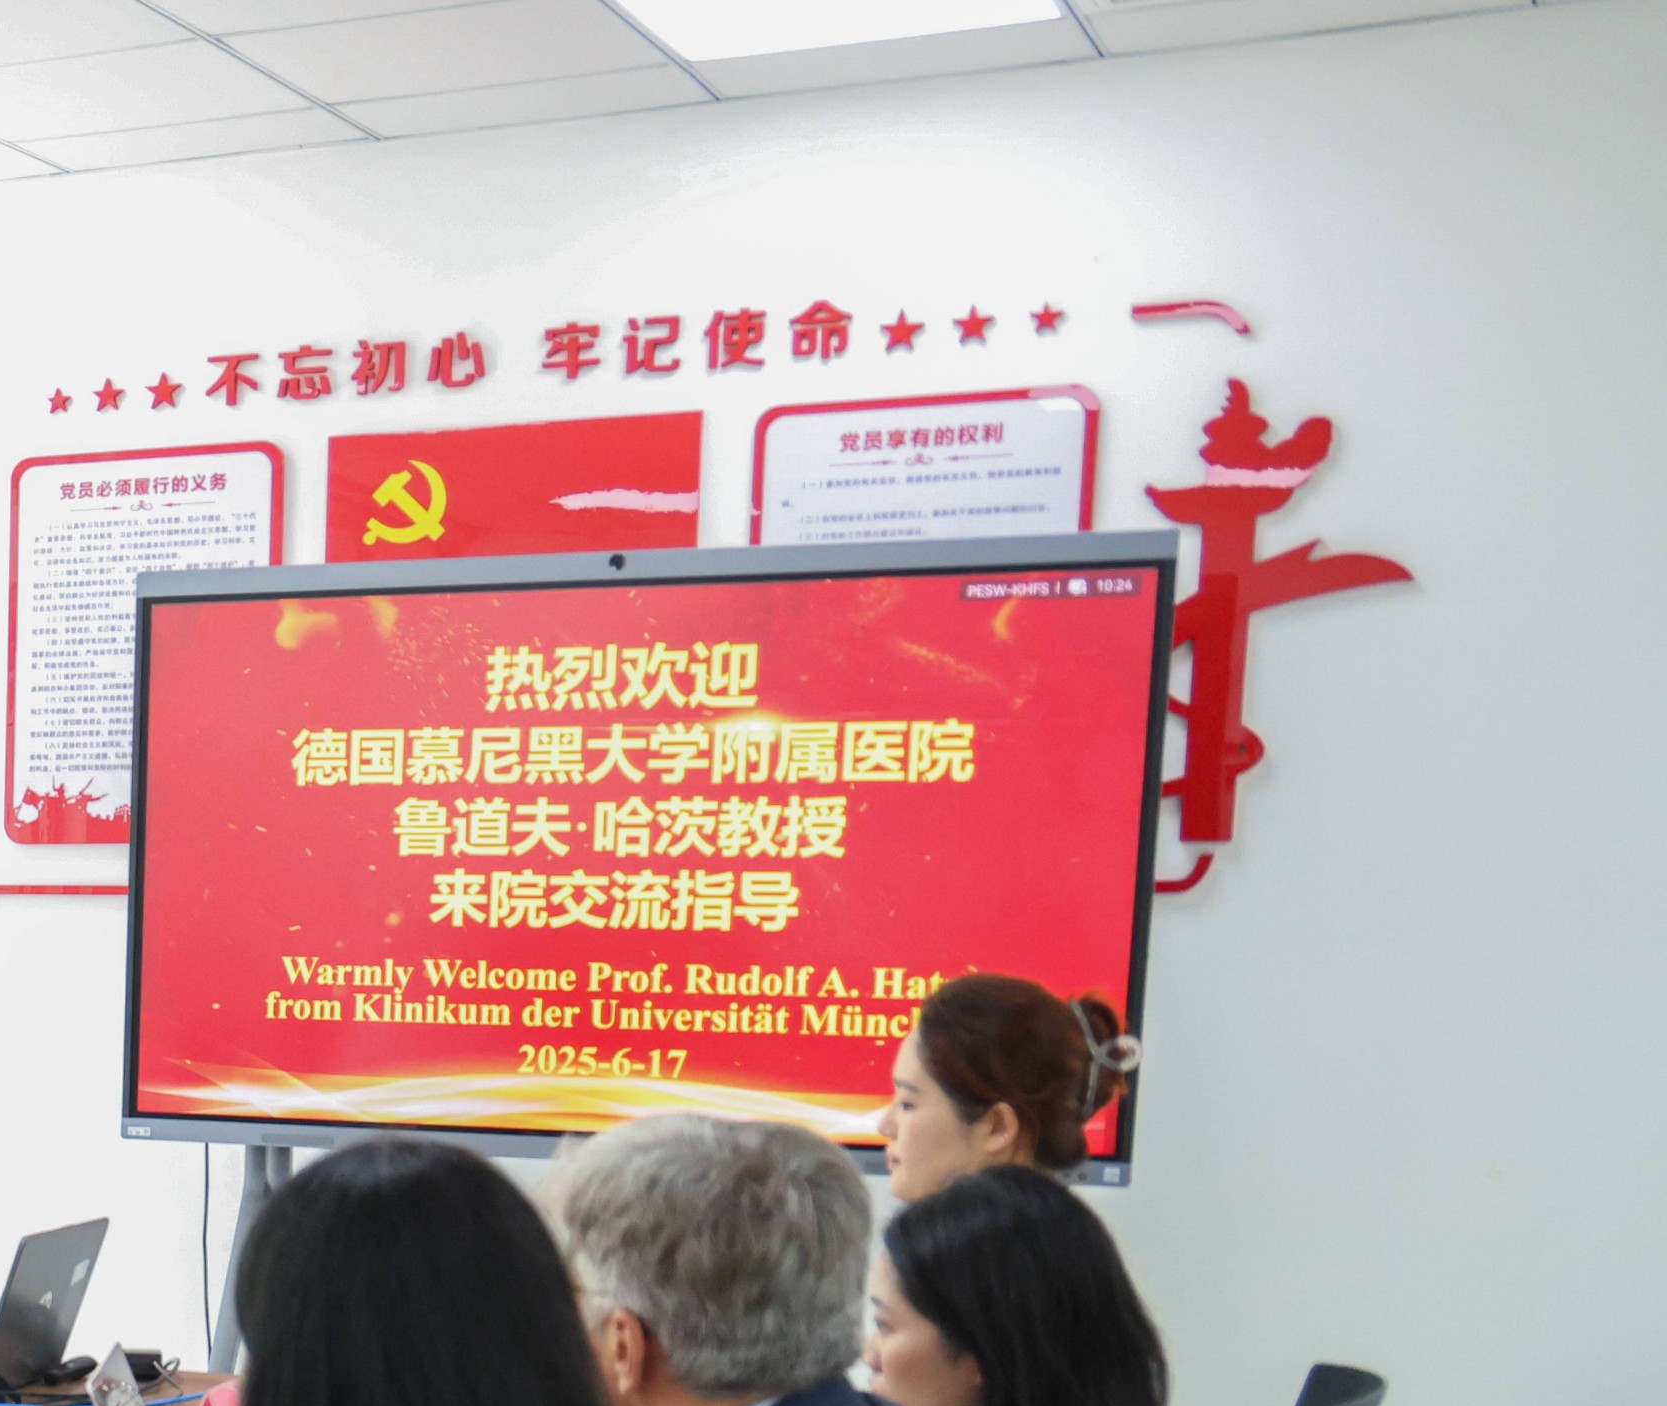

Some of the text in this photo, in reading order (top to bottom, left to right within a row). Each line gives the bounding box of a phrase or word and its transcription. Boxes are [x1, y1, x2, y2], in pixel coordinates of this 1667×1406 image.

[205, 299, 854, 407] 不忘初心 牢记使命
[839, 421, 1005, 453] 党员享有的权利
[59, 472, 228, 501] 党员必须履行的义务
[485, 641, 759, 712] 热烈欢迎
[291, 717, 976, 787] 德国慕尼黑大学附属医院
[430, 868, 799, 933] 来院交流指导
[281, 955, 944, 1002] Warmly Welcome Prof. Rudolf A. Hat
[264, 990, 342, 1021] from
[352, 991, 512, 1027] Klinikum
[521, 996, 580, 1028] der
[589, 997, 790, 1035] Universität
[517, 1044, 688, 1079] 2025-6-17
